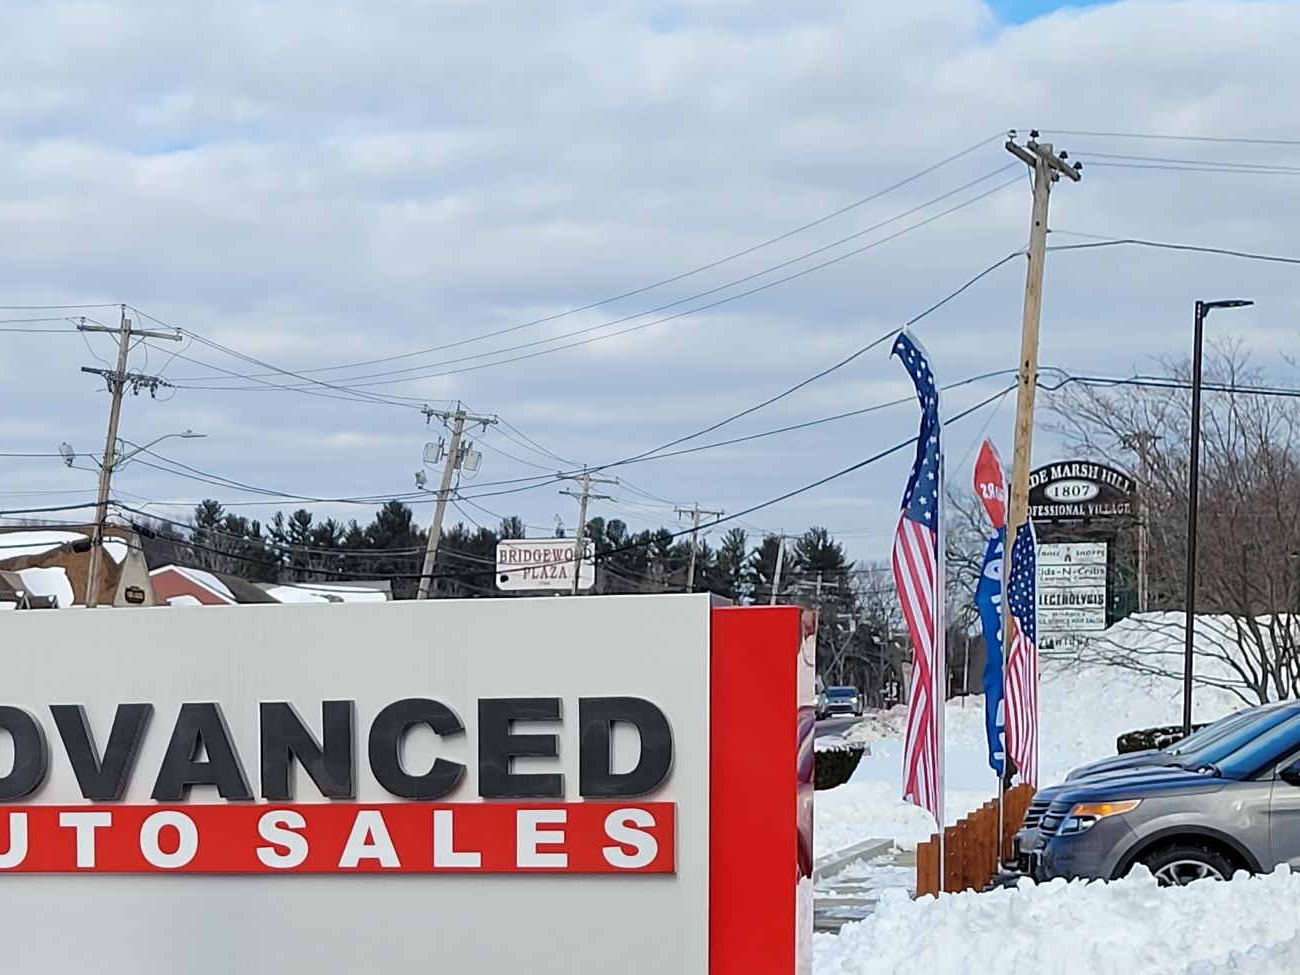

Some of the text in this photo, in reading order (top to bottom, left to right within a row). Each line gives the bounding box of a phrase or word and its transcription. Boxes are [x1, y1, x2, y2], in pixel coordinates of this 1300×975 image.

[1029, 463, 1131, 496] DE MARSH HILL
[1054, 485, 1090, 497] 1807
[1027, 503, 1086, 517] OFESSIONAL
[500, 547, 592, 564] BRIDGEWOD
[523, 565, 567, 580] PLAZA
[1038, 567, 1105, 577] ids-N-Cribs
[1038, 594, 1104, 606] LECTROLYSIS
[256, 807, 659, 870] SALES
